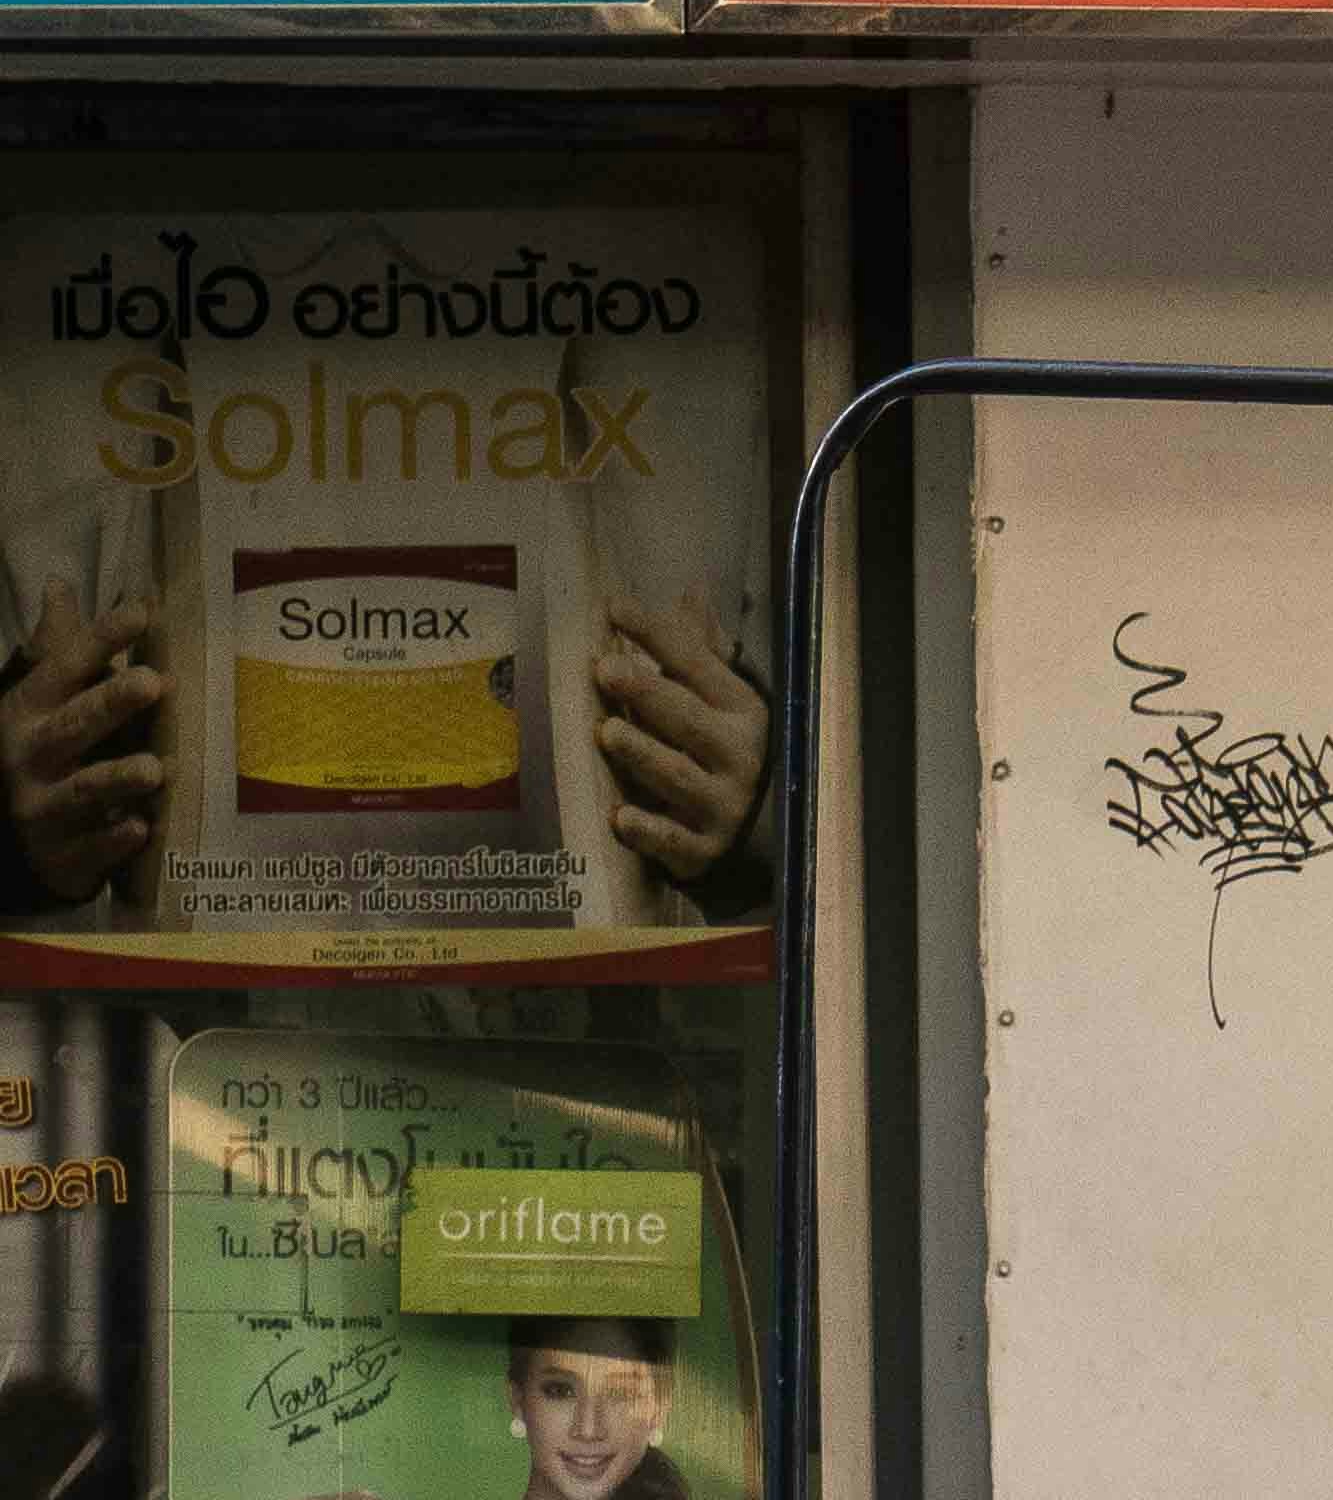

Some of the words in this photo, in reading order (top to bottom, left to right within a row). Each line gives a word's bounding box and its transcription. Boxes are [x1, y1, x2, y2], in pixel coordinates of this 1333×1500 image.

[293, 247, 701, 340] อย่างนี้ต้อง
[98, 355, 657, 488] Solmax
[278, 595, 471, 641] Solmax
[342, 646, 407, 663] Capsule
[299, 1076, 322, 1111] 3
[437, 1197, 667, 1246] oriflame
